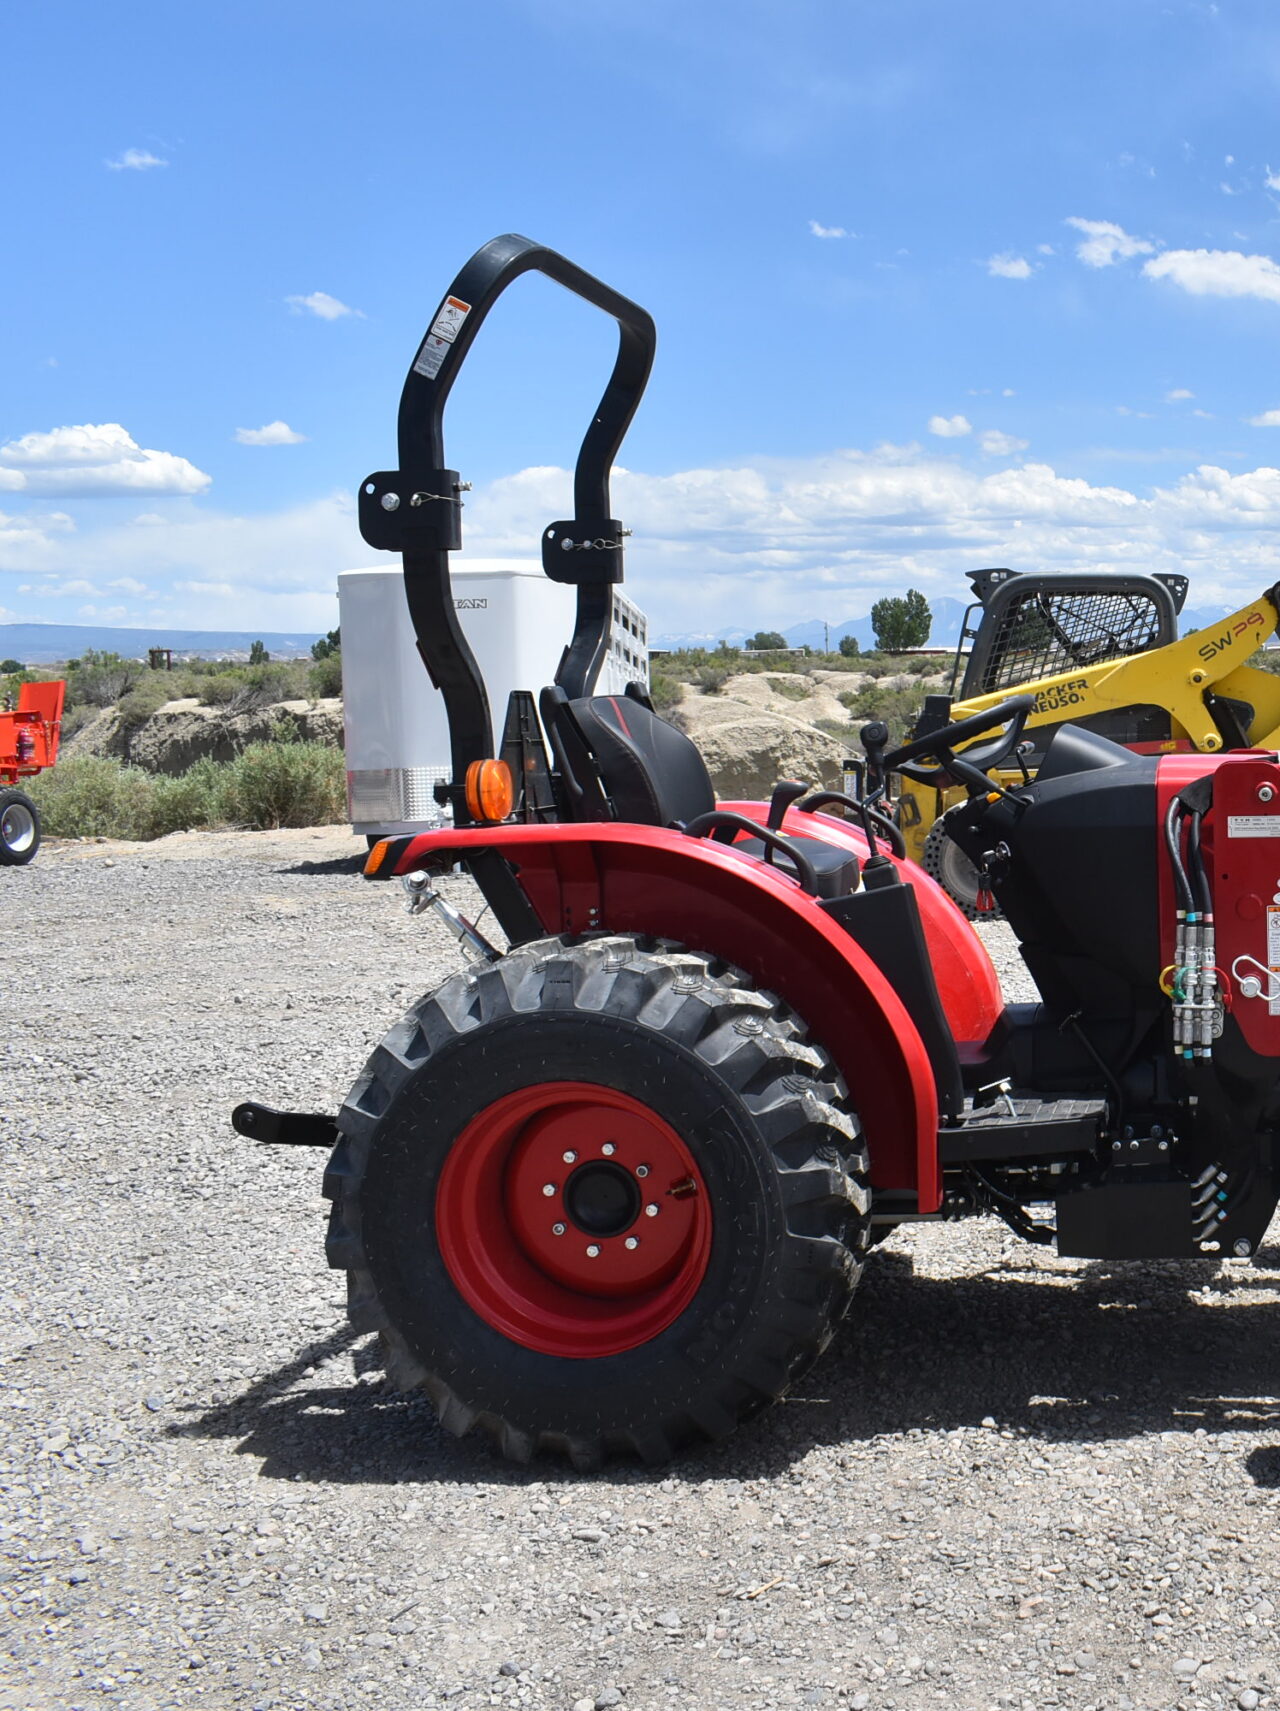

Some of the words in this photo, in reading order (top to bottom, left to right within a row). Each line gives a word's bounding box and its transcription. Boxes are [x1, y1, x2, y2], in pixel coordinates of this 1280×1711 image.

[453, 598, 487, 609] TAN
[1034, 679, 1089, 702] ACKER
[1029, 692, 1086, 716] NEUSO
